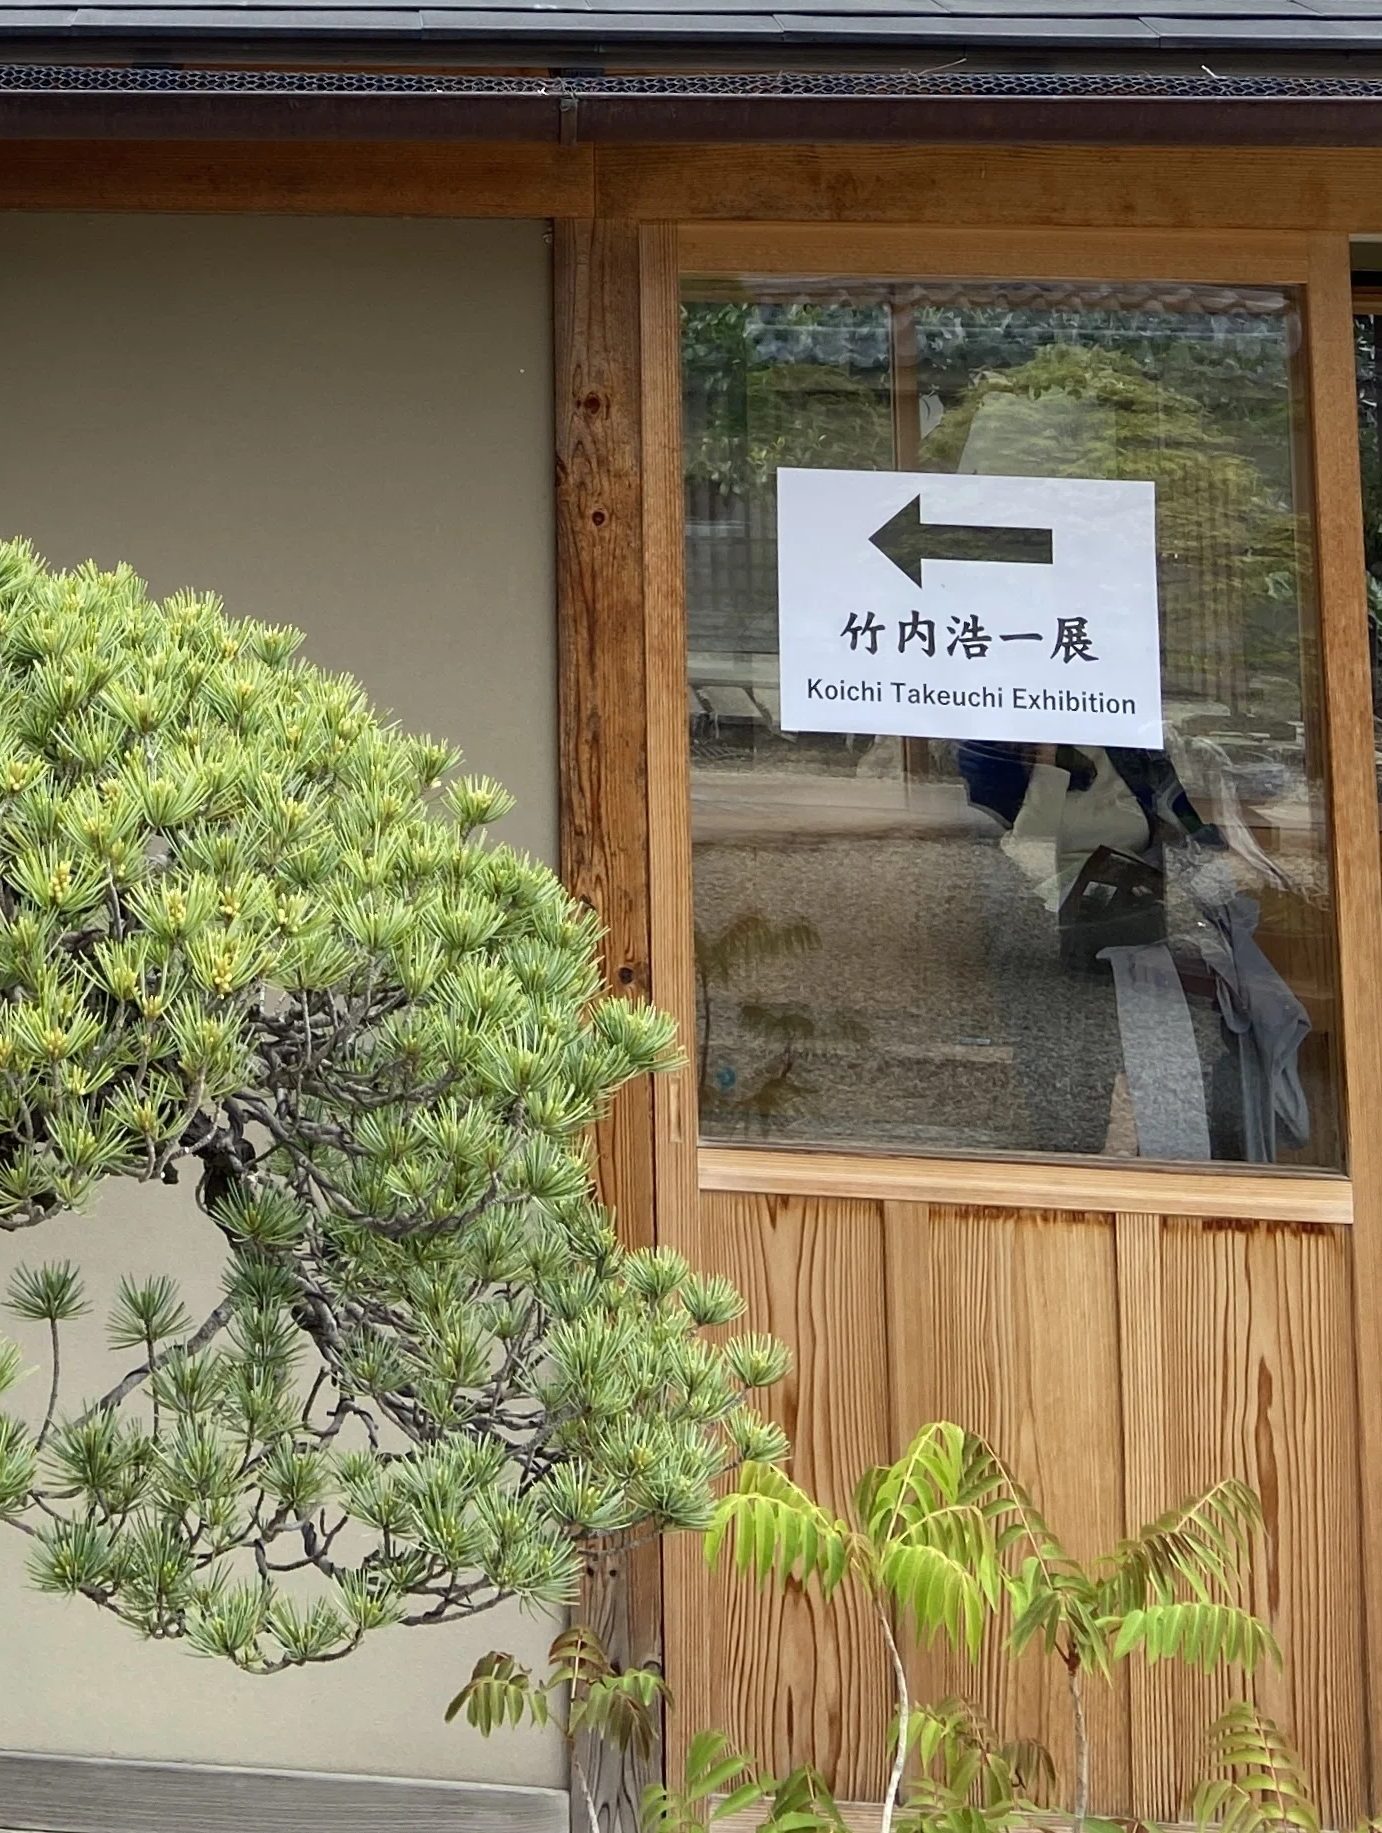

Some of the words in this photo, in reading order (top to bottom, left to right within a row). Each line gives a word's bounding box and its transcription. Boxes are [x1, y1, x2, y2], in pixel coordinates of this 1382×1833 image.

[840, 610, 1099, 664] 竹内浩一展
[807, 678, 882, 702] Koichi
[890, 682, 1003, 709] Takeuchi
[1012, 688, 1136, 715] Exhibition
